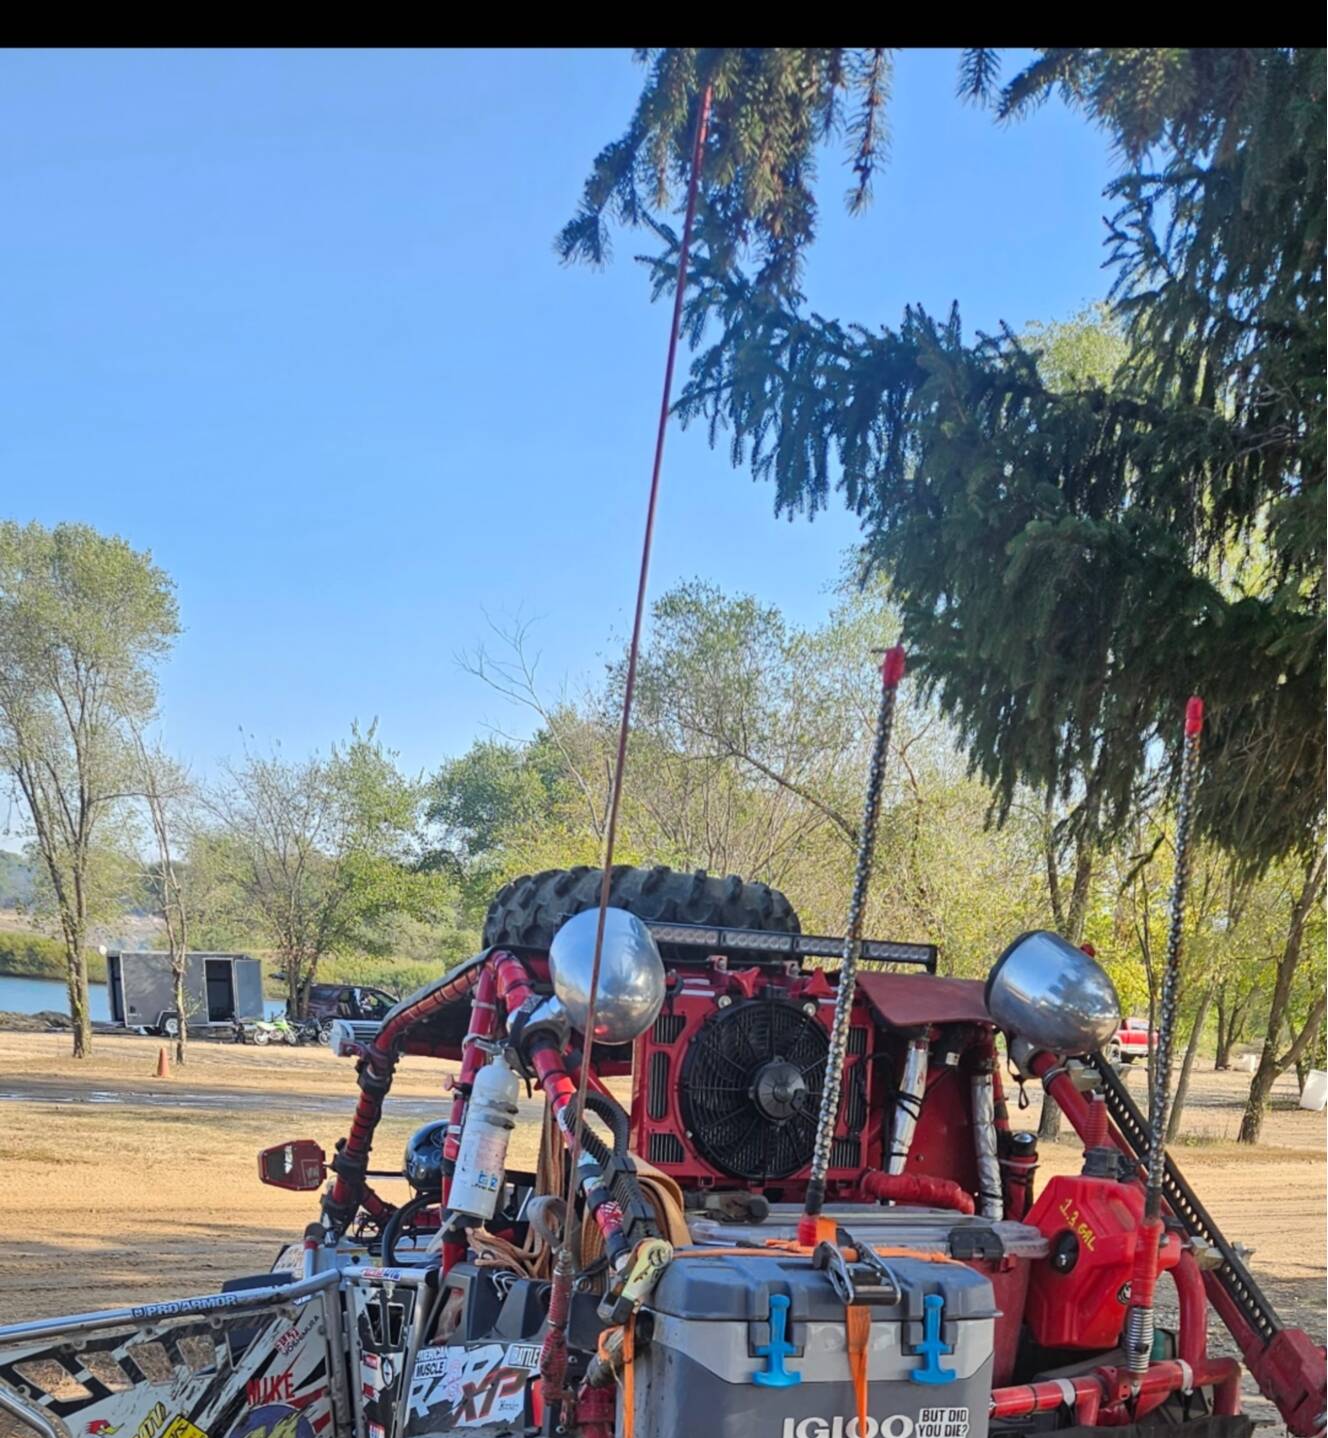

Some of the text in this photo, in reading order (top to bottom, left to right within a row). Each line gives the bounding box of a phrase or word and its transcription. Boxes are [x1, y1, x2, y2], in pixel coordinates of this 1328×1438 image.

[146, 1294, 239, 1317] PRO ARMOR
[415, 1361, 444, 1377] MUSCLE
[246, 1371, 296, 1406] MIKE
[922, 1408, 968, 1423] BUT DID
[918, 1423, 968, 1438] YOU DIE?
